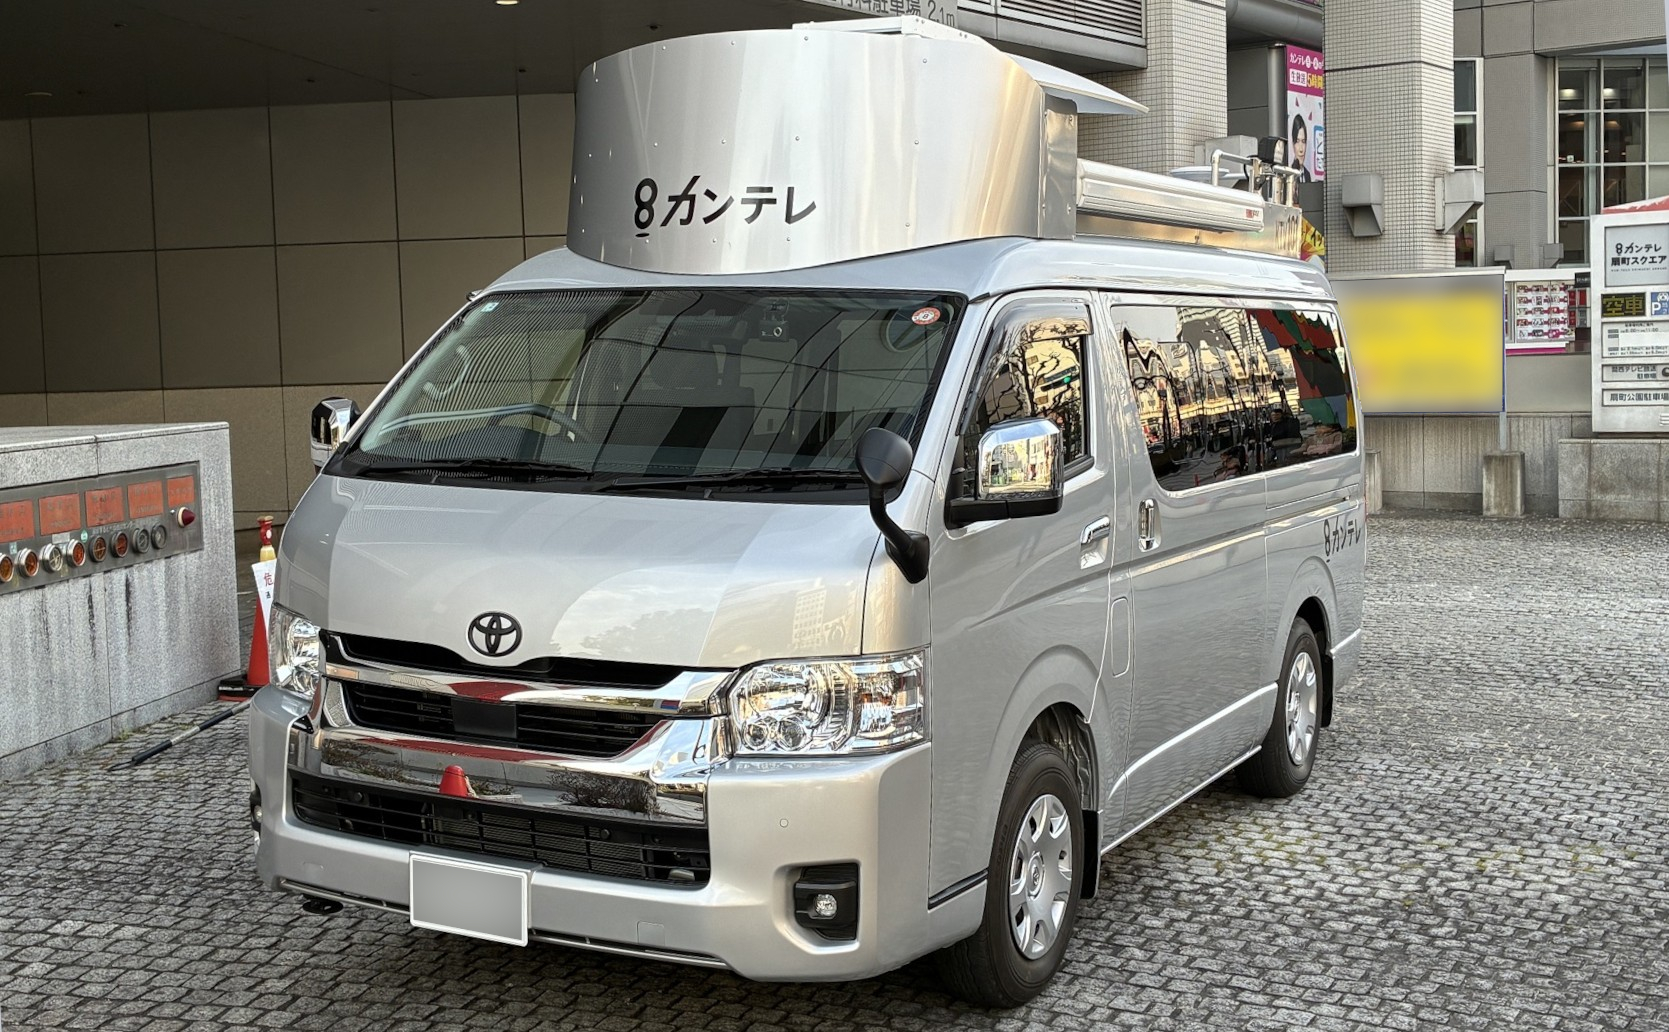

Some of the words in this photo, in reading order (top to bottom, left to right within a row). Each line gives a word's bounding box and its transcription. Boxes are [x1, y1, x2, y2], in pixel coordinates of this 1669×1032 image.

[1610, 255, 1667, 267] 扇町スクエア
[1602, 295, 1644, 317] 空車
[1651, 301, 1661, 315] P
